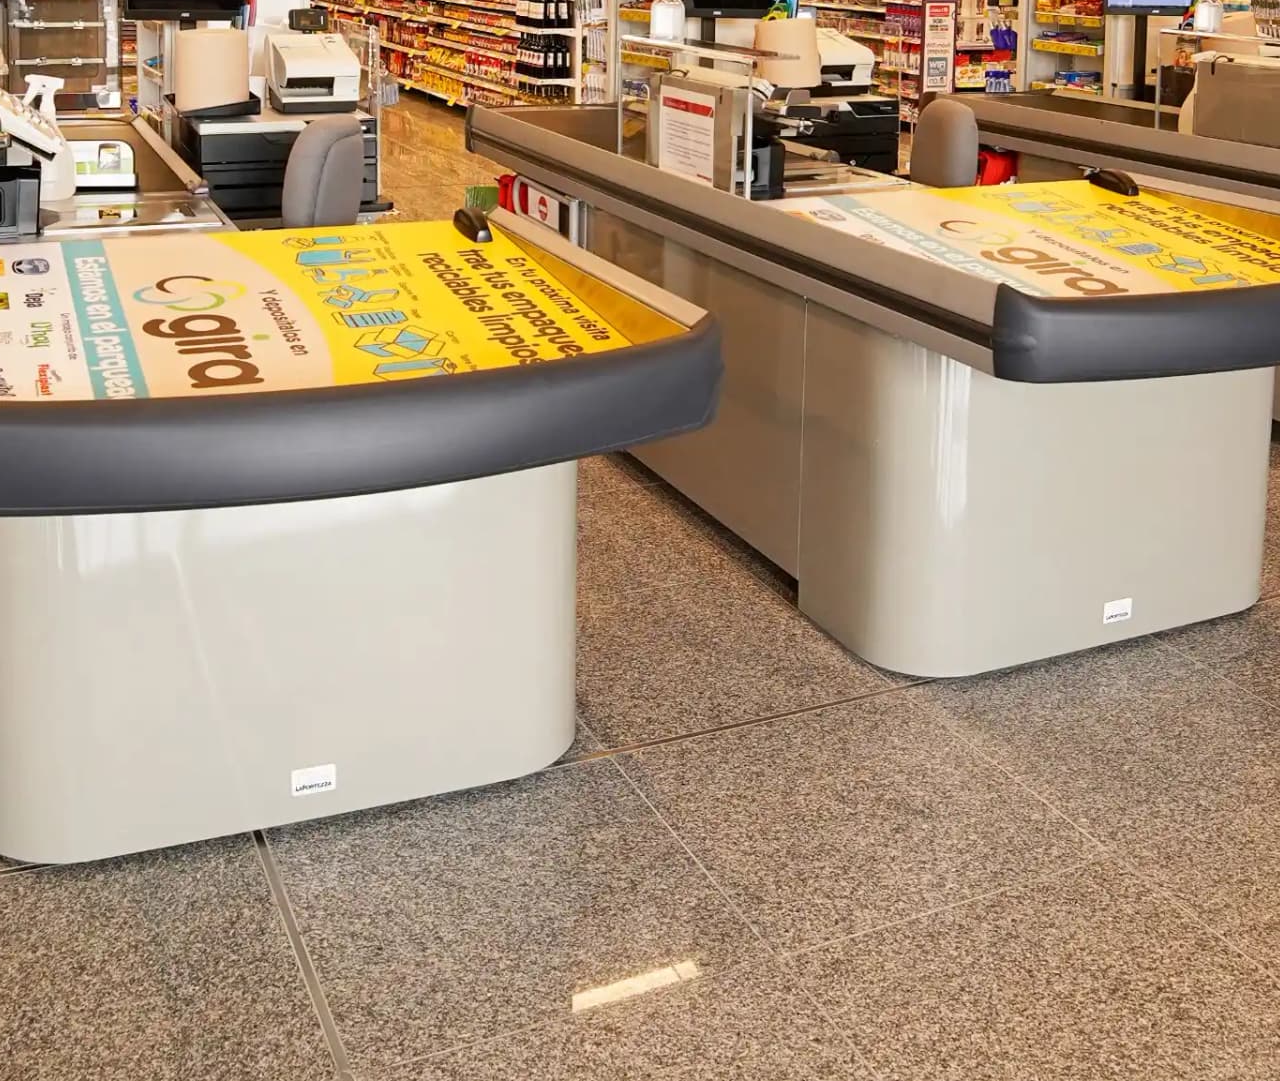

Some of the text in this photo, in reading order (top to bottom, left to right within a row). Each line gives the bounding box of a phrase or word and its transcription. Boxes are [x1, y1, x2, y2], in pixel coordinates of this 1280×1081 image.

[1098, 202, 1213, 247] reciclables
[1123, 200, 1166, 219] trae
[1167, 217, 1203, 231] tus
[1167, 205, 1187, 215] En
[1189, 213, 1206, 222] tu
[1208, 219, 1276, 250] próxima
[75, 256, 111, 303] Estamos
[417, 251, 494, 314] reciclables
[457, 248, 495, 271] trae
[483, 271, 515, 290] tus
[980, 246, 1129, 296] gira
[1109, 264, 1130, 275] en
[23, 292, 44, 309] Deja
[87, 304, 113, 320] en
[506, 257, 610, 342] En tu próxima visita
[92, 321, 128, 334] el
[262, 296, 302, 343] depositalos
[290, 345, 309, 356] en
[142, 314, 269, 389] gira
